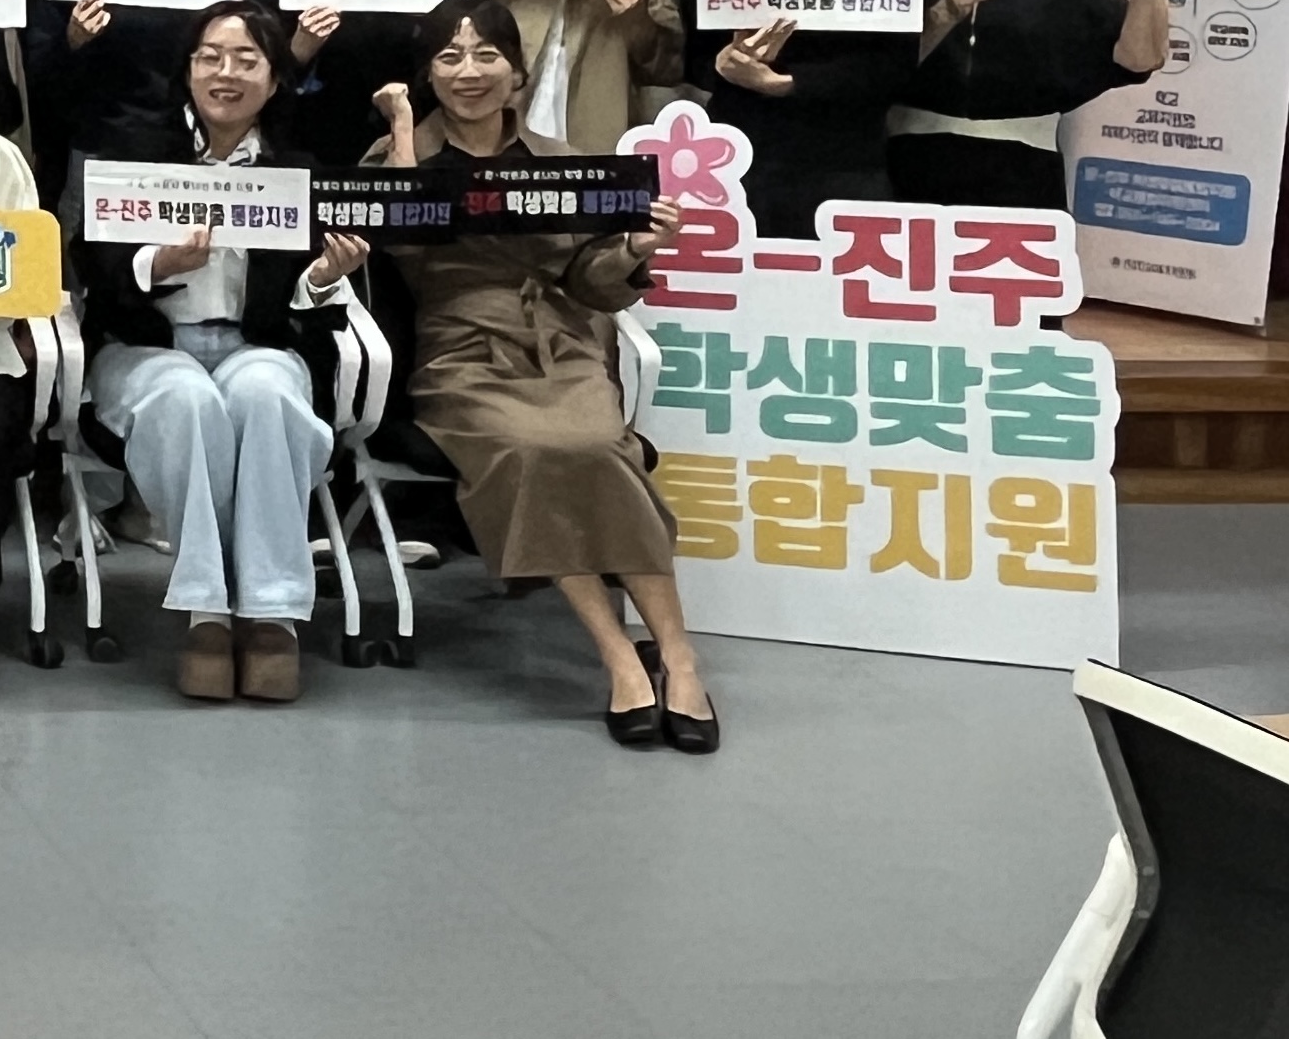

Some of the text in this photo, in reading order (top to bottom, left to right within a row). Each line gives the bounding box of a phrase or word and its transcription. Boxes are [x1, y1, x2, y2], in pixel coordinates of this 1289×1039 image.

[643, 209, 1064, 327] 온-진주
[646, 322, 1101, 461] 학생맞춤
[654, 451, 1098, 593] 통합지원
